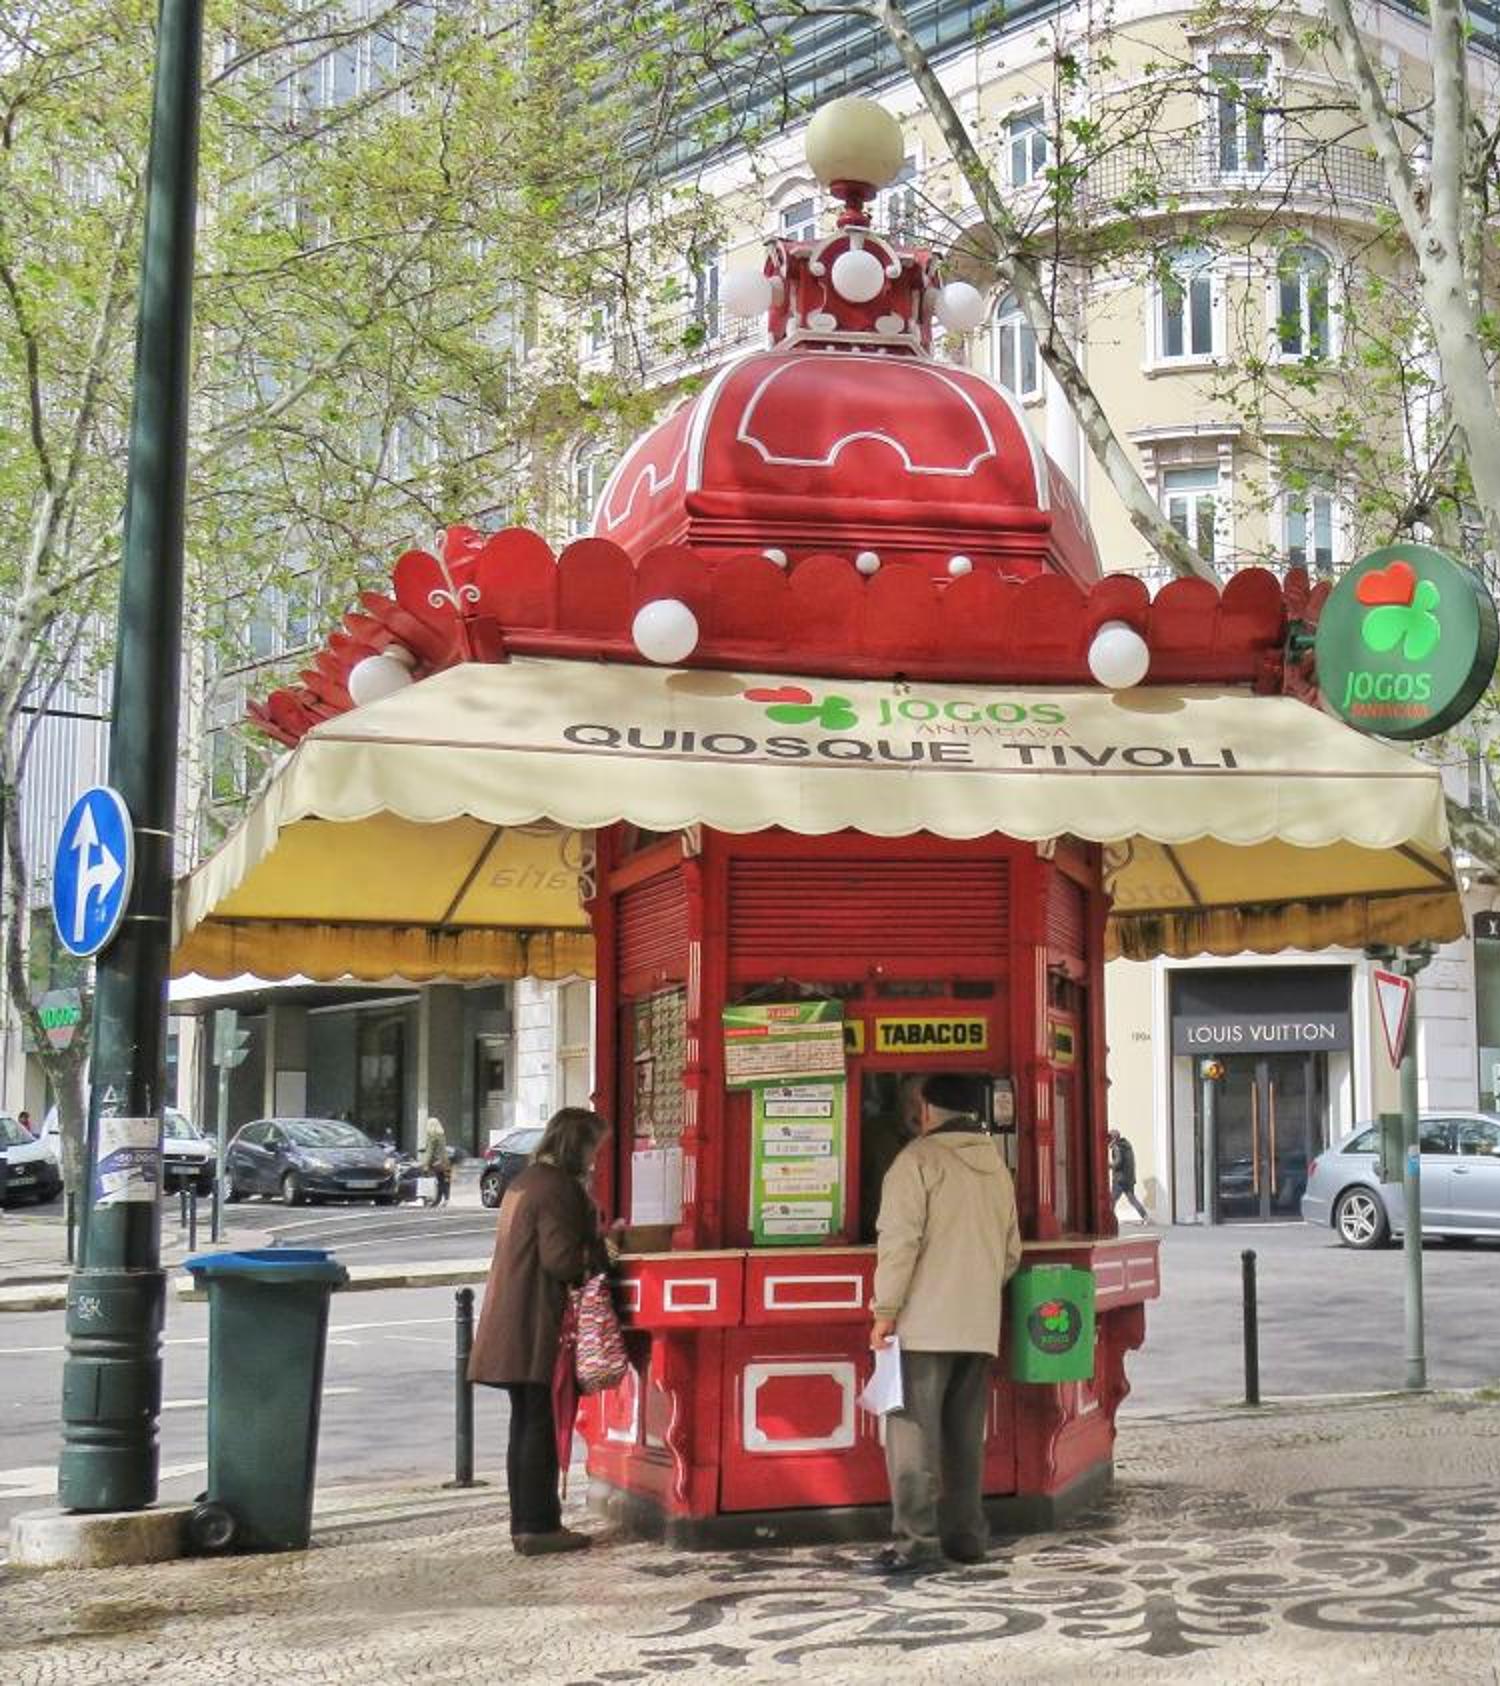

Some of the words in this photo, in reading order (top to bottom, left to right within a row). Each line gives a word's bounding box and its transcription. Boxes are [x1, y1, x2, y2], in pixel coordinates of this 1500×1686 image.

[1342, 671, 1433, 707] JOGOS
[878, 696, 1067, 727] JOGOS
[563, 723, 974, 764] QUIOSQUE
[1002, 742, 1238, 769] TIVOLI
[880, 1023, 983, 1046] TABACOS
[1187, 1024, 1243, 1043] LOUIS
[1249, 1023, 1335, 1041] VUITTON
